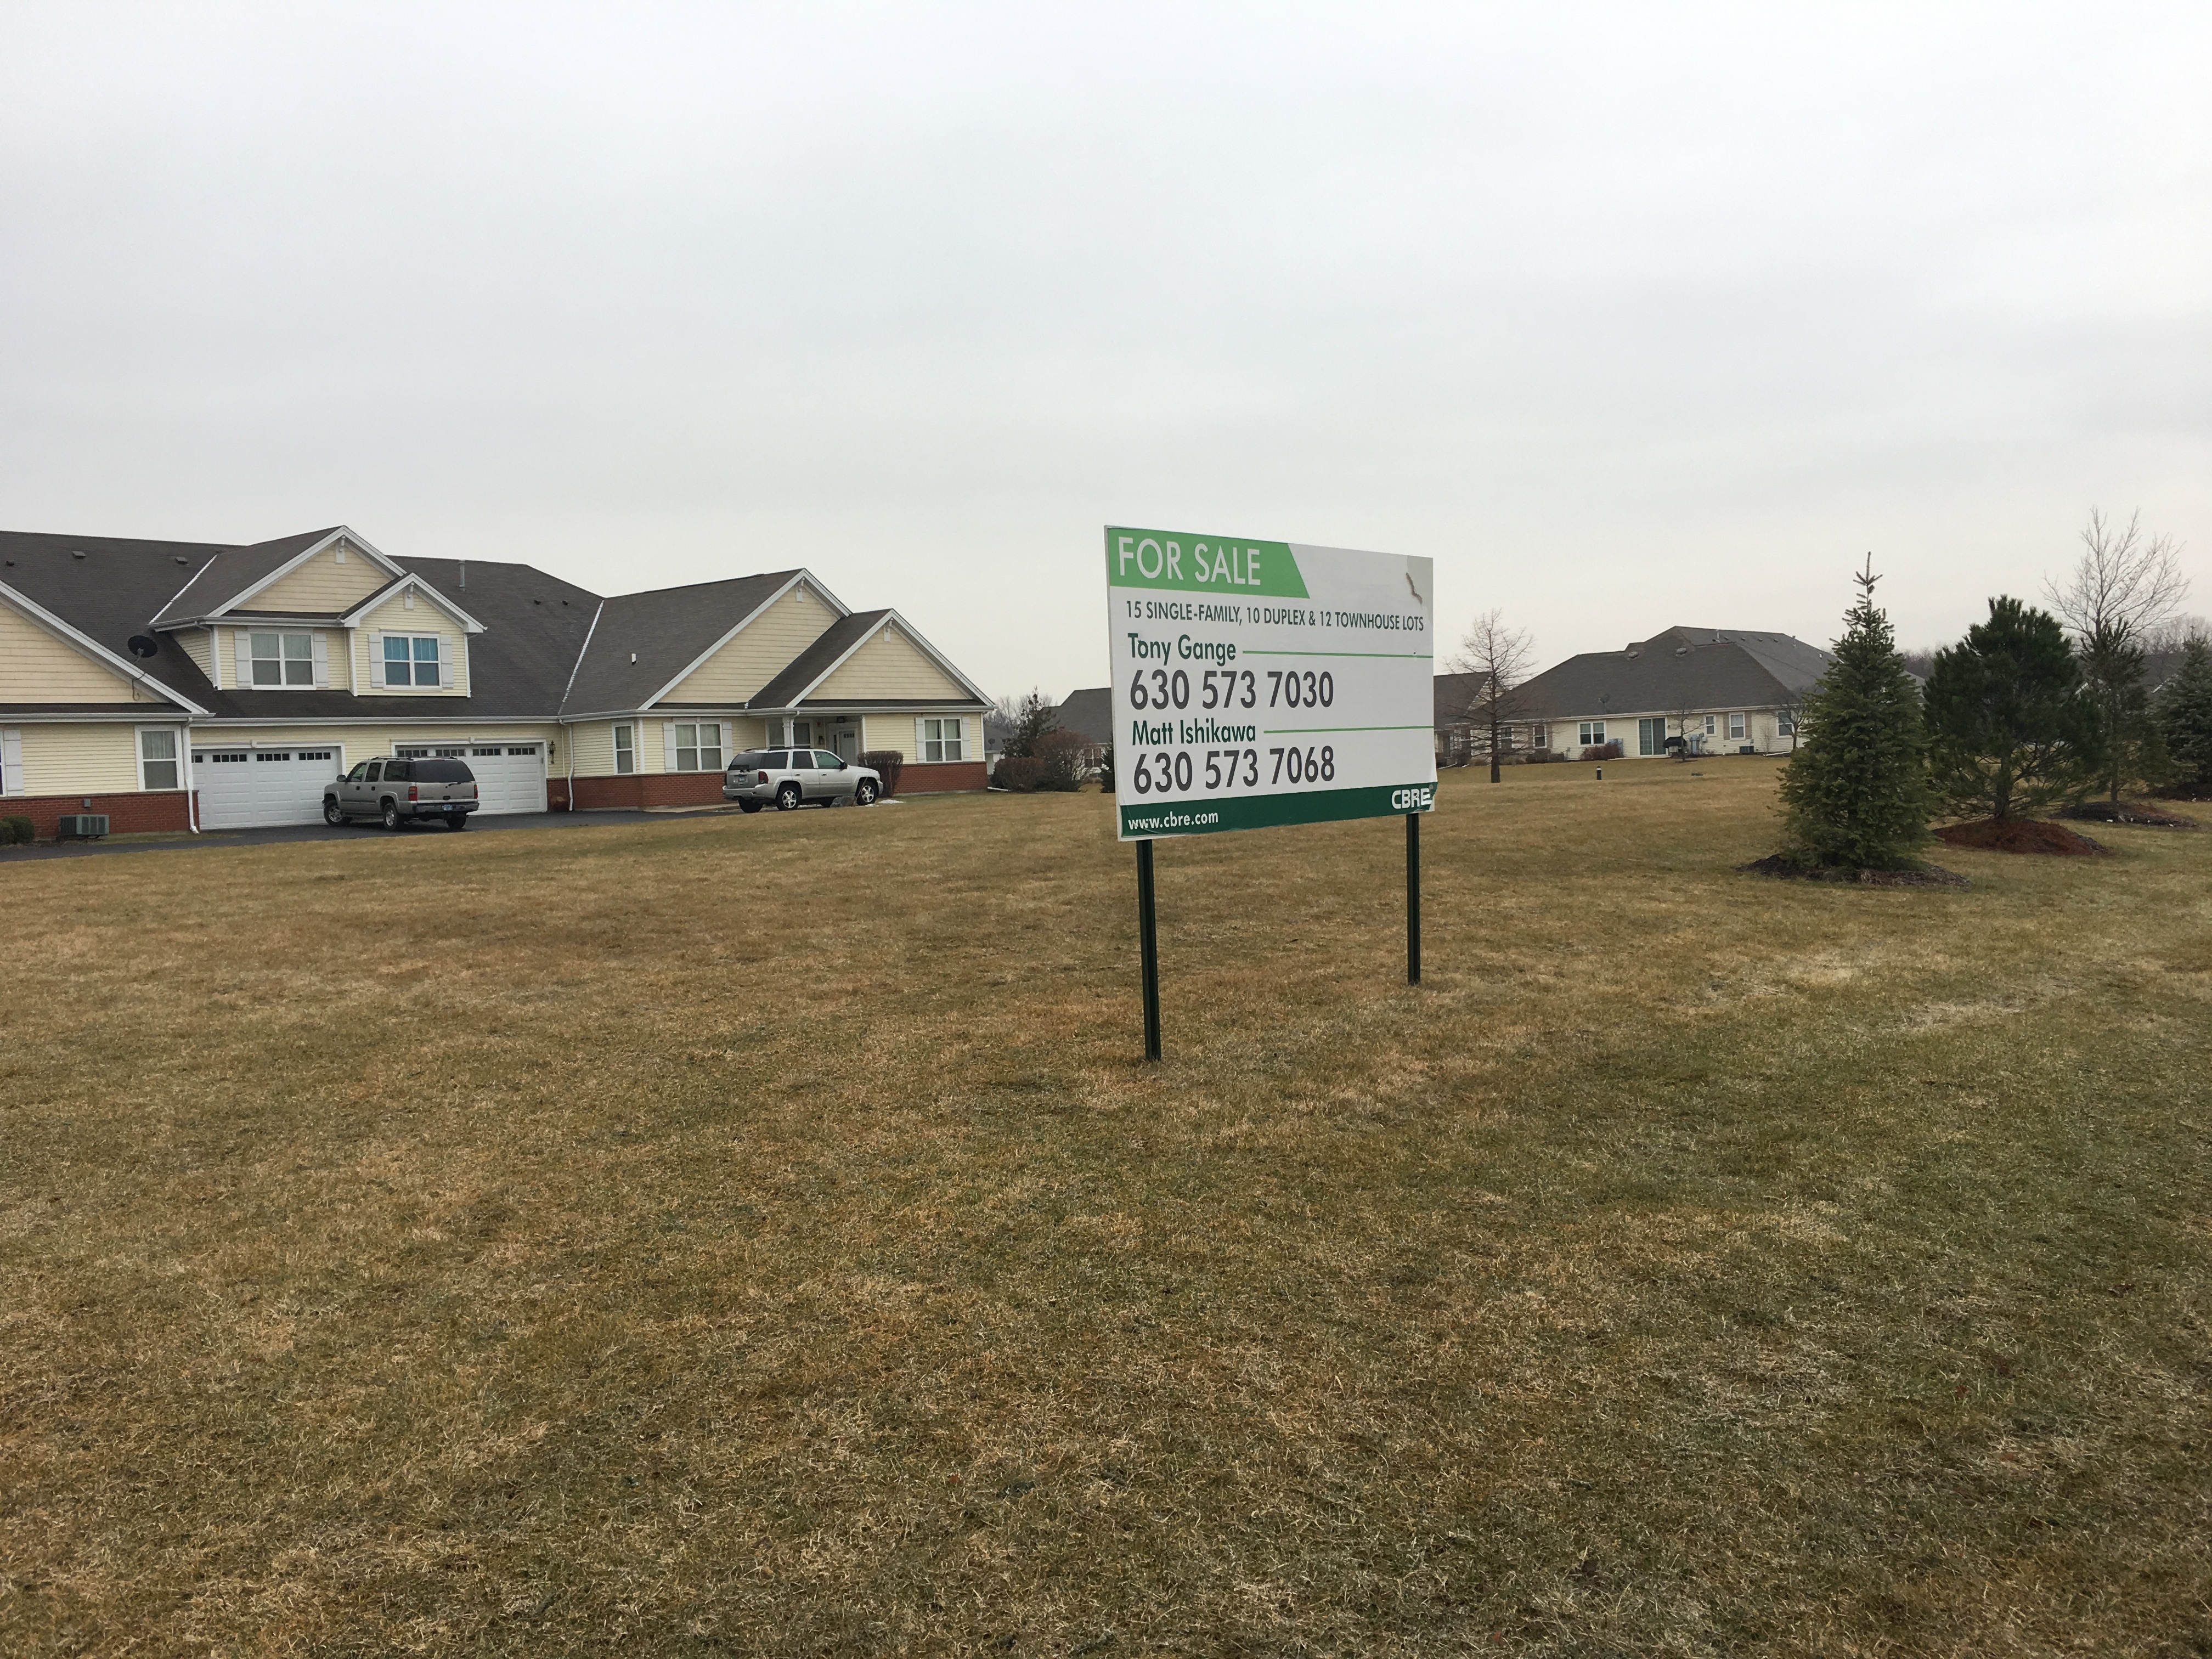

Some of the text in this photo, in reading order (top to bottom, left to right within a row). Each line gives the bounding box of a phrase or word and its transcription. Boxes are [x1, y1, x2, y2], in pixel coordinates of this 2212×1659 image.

[1119, 537, 1261, 585] FOR SALE
[1126, 601, 1424, 631] 15 SINGLE-FAMILY, 10 DUPLEX & 12 TOWNHOUSE LOTS
[1127, 633, 1236, 667] Tony Gange
[1130, 669, 1334, 710] 630 573 7030
[1132, 718, 1256, 746] Matt Ishikawa
[1133, 746, 1335, 794] 630 573 7068
[1391, 788, 1432, 809] CBRE
[1128, 811, 1218, 830] www.cbre.com
